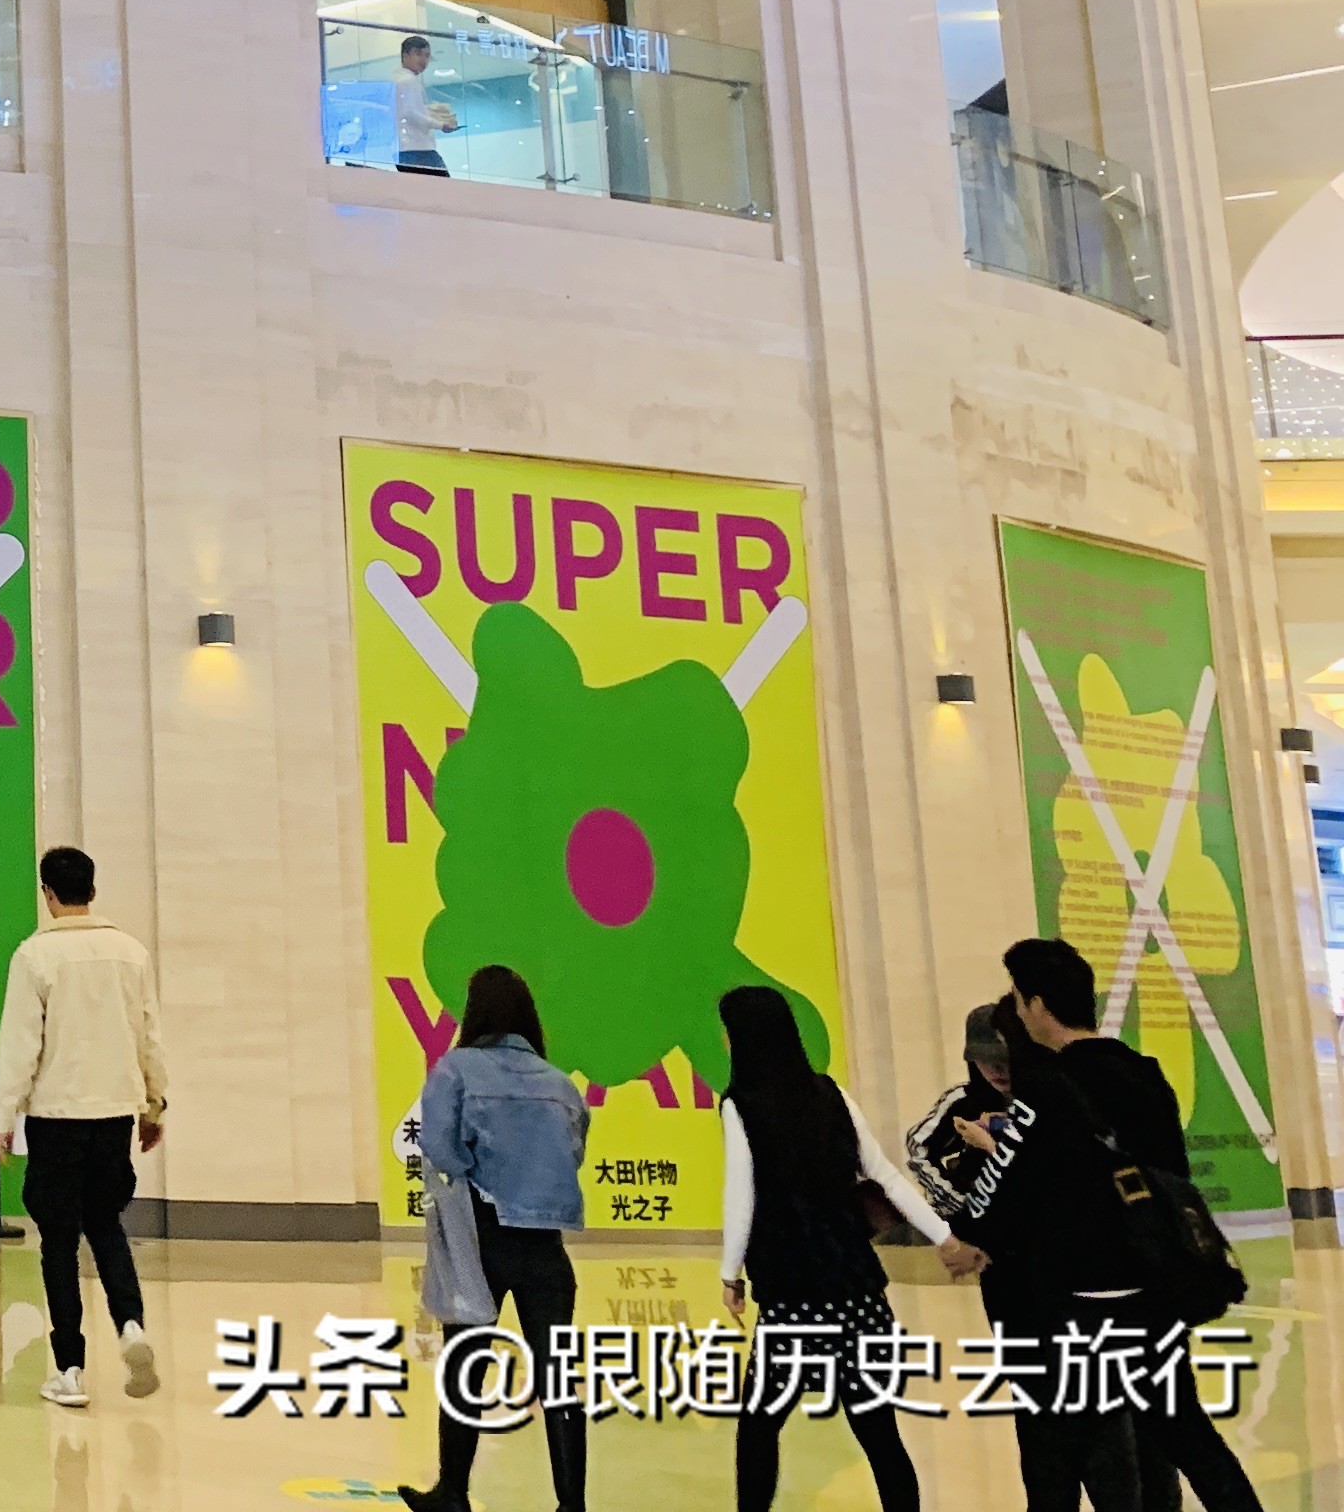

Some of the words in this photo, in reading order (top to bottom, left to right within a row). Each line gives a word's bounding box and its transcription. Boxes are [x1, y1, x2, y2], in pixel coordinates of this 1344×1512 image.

[369, 479, 792, 625] SUPER
[595, 1158, 678, 1186] 大田作物
[611, 1194, 673, 1222] 光之子
